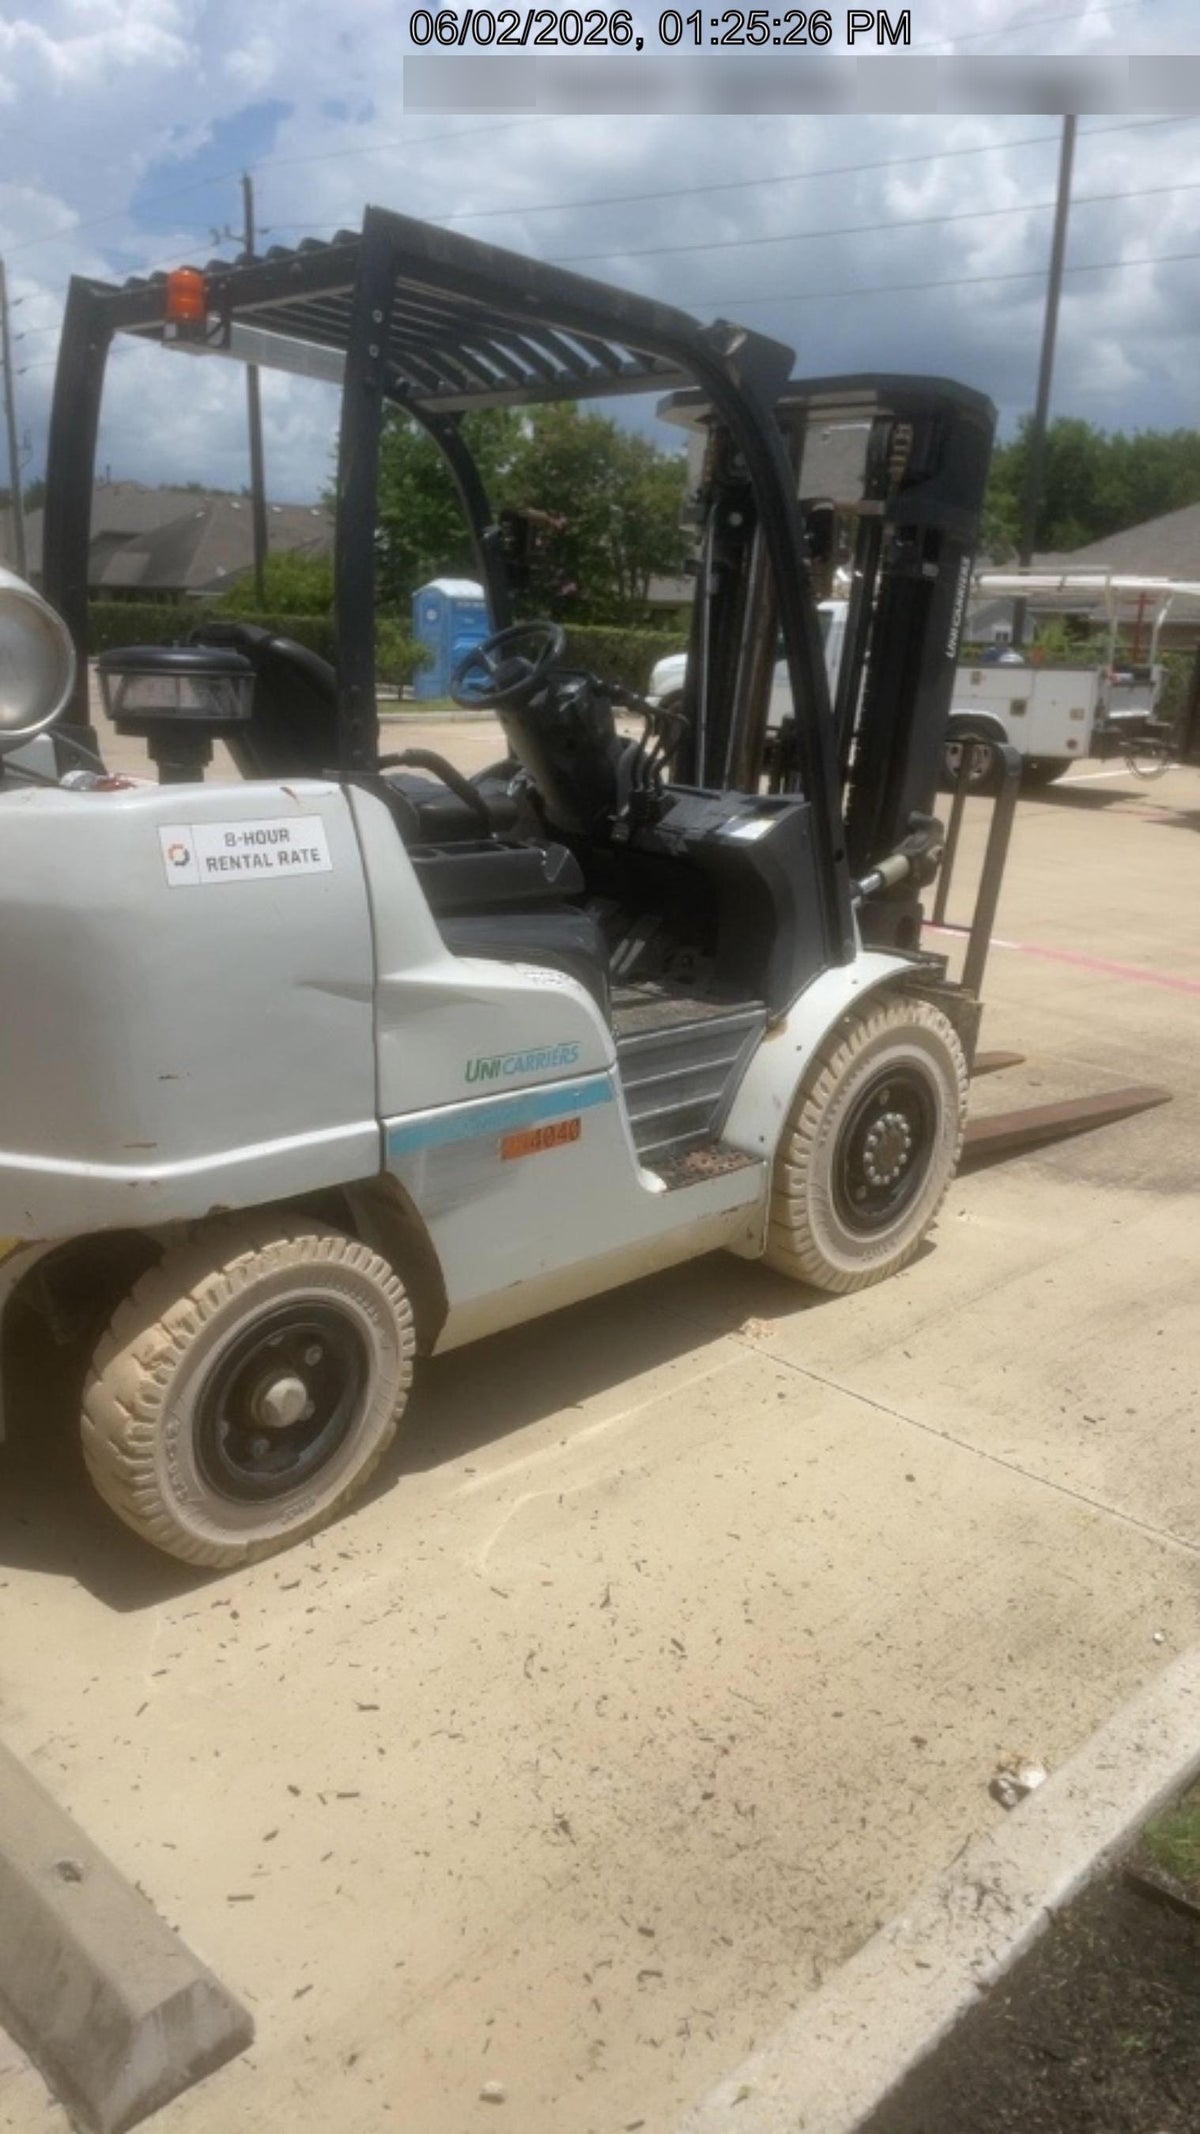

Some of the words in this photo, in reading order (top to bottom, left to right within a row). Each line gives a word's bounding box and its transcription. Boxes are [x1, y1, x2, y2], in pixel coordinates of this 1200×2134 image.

[224, 828, 290, 847] 8-HOUR
[205, 852, 273, 873] RENTAL
[278, 848, 321, 866] RATE
